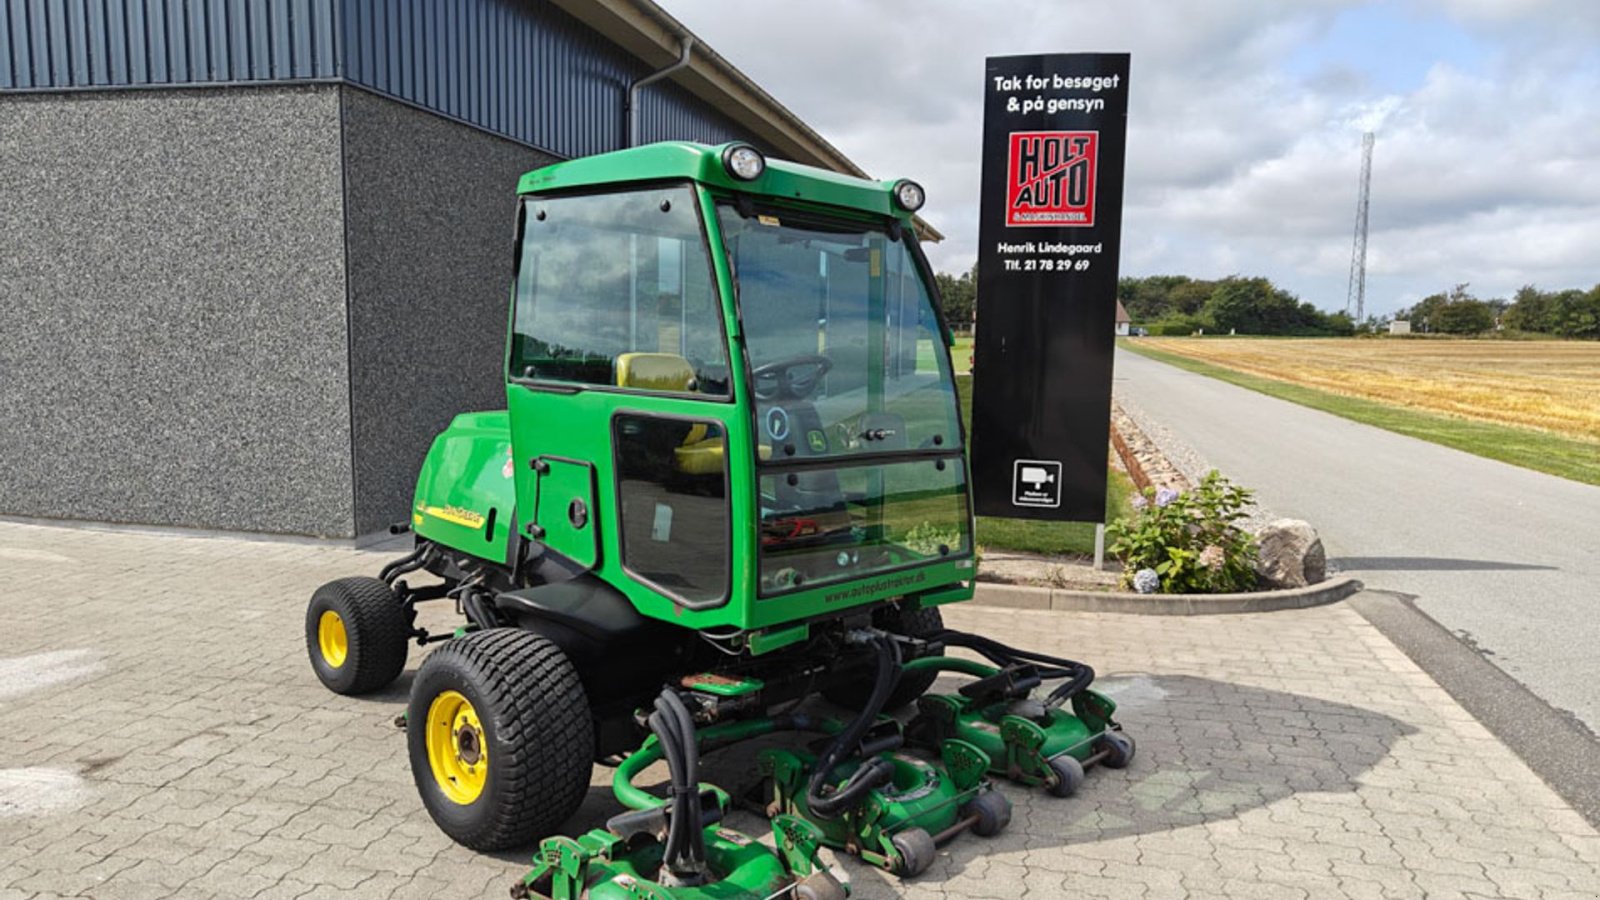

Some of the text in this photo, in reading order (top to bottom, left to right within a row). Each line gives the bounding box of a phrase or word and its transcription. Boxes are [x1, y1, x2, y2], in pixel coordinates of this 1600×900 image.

[994, 73, 1120, 92] Tak for besøget
[1006, 95, 1104, 115] & på gensyn
[1018, 136, 1090, 187] HOLT
[1013, 158, 1089, 208] AUTO
[997, 242, 1102, 256] Henrik Lindegaard
[1004, 259, 1090, 271] Tlf. 21 78 29 69
